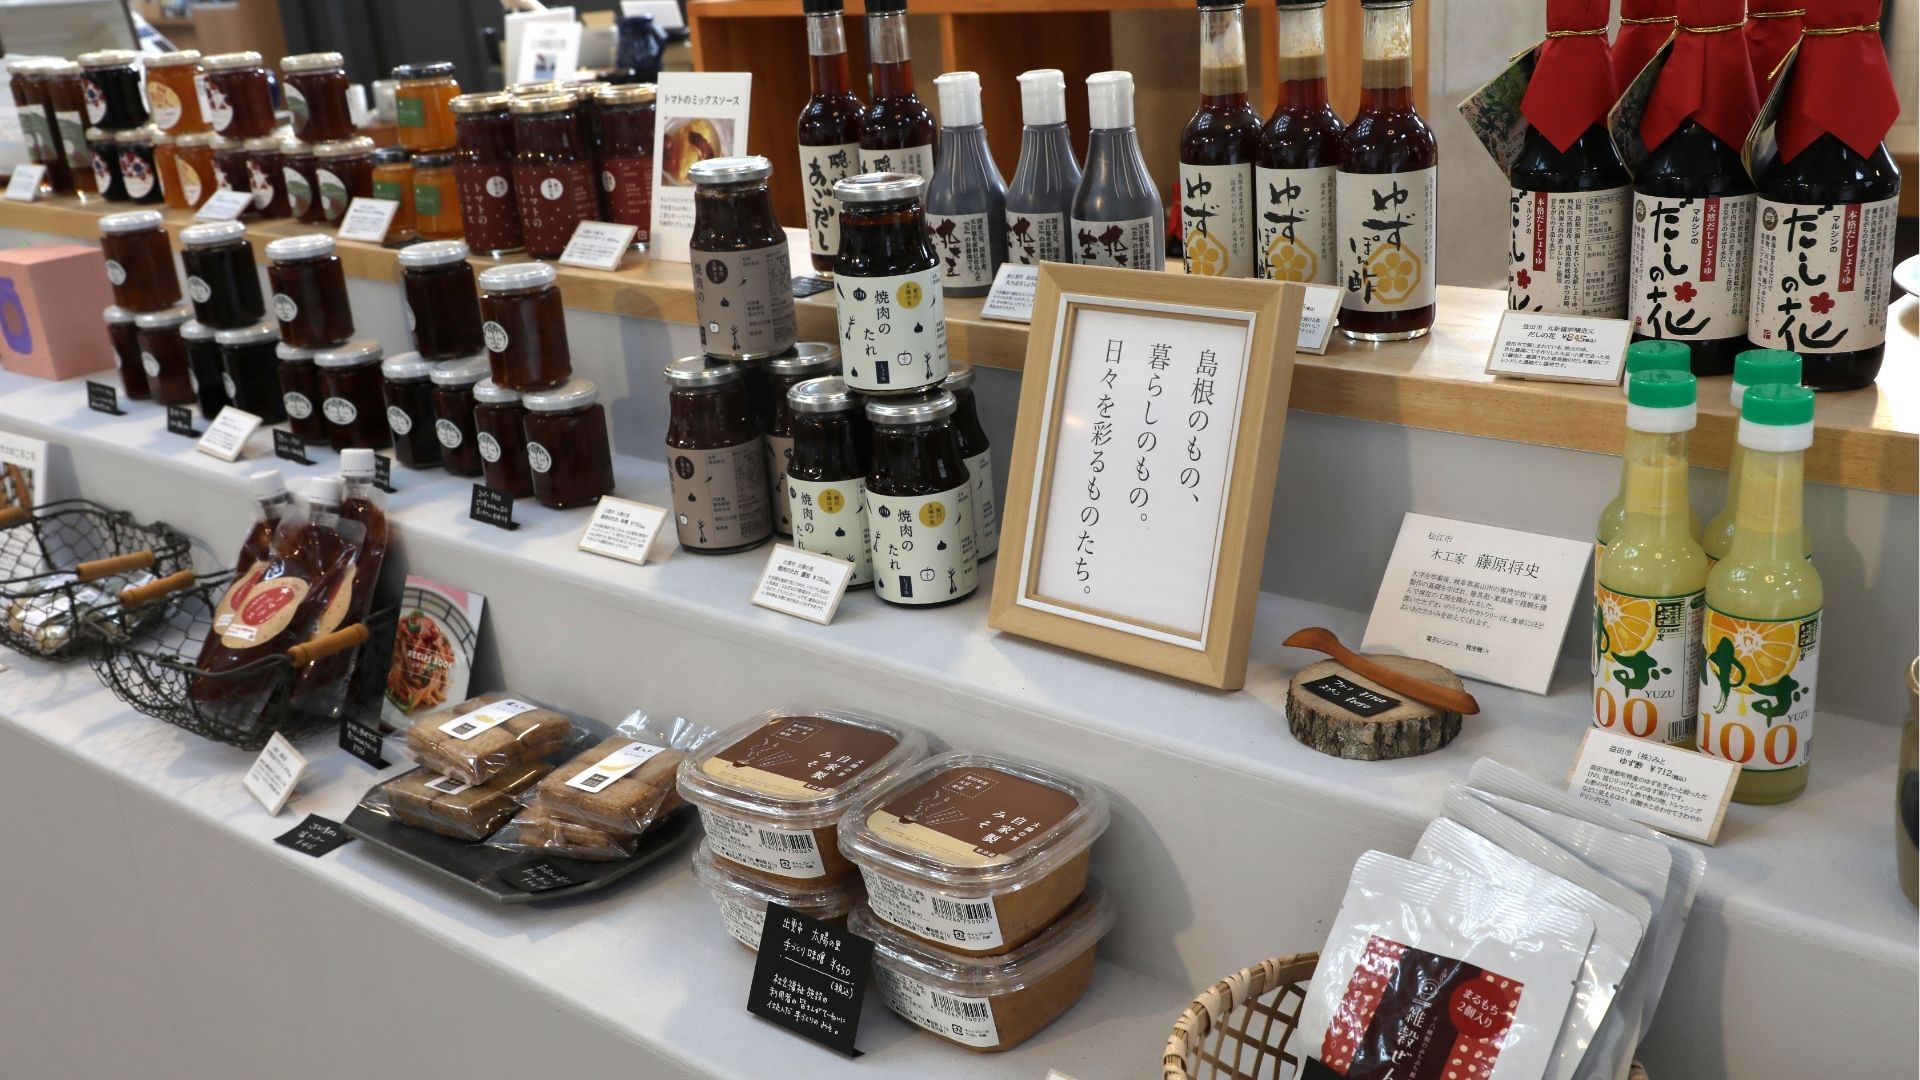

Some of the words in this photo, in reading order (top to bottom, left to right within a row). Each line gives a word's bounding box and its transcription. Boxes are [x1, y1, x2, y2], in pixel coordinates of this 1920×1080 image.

[664, 94, 740, 106] トマトのミックスソース
[475, 183, 487, 225] トマトの
[529, 185, 543, 228] トマトの
[808, 155, 835, 251] あごだし
[1183, 173, 1220, 239] ゆず
[1264, 177, 1310, 245] ゆず
[1362, 181, 1415, 251] ゆず
[1535, 198, 1545, 265] 本格だししょうゆ
[1691, 208, 1700, 245] マルシンの
[1703, 204, 1716, 274] 天然だししょうゆ
[1829, 215, 1841, 253] マルシンの
[1842, 210, 1858, 284] 本格だししょうゆ
[1348, 235, 1380, 304] ぽん酢
[1647, 197, 1711, 339] だしの花
[1778, 204, 1848, 352] だしの花
[874, 290, 891, 335] 焼肉の
[864, 328, 878, 357] たれ
[1528, 331, 1556, 340] だしの花
[1129, 343, 1172, 522] 暮らしのもの。
[1180, 349, 1218, 503] 島根のもの、
[1075, 339, 1124, 594] 日々を彩るものたち。
[801, 492, 814, 534] 焼肉の
[897, 509, 914, 552] 焼肉の
[796, 525, 806, 550] たれ
[1428, 531, 1453, 543] 松江市
[777, 565, 799, 576] 焼肉のたれ
[888, 543, 901, 570] たれ
[1430, 548, 1467, 565] 木工家
[1475, 553, 1540, 579] 藤原将史
[407, 650, 432, 664] RECIPE
[1645, 690, 1675, 698] YUZU
[1700, 636, 1810, 728] ゆず
[1609, 745, 1633, 757] 益田市
[1637, 751, 1666, 766] (株)みと
[1700, 712, 1798, 765] 100
[807, 751, 832, 768] みそ
[811, 755, 852, 781] 自家製
[1619, 757, 1643, 770] ゆず酢
[1579, 792, 1612, 807] ドリンクにも。
[1582, 785, 1702, 823] などに使えるほか、炭酸水と合わせてさわやか
[1585, 778, 1703, 814] お酢の代わりにすし酢や酢の物、ドレッシング
[979, 810, 1006, 829] みそ
[981, 816, 1027, 844] 自家製
[1010, 822, 1041, 842] 太陽の里
[783, 938, 826, 964] 手づくり味噌
[830, 958, 851, 976] ¥450
[811, 928, 841, 951] 太陽の里
[830, 982, 853, 999] (税込)
[1462, 988, 1499, 1016] まるもち
[1456, 1001, 1493, 1028] 2個入り
